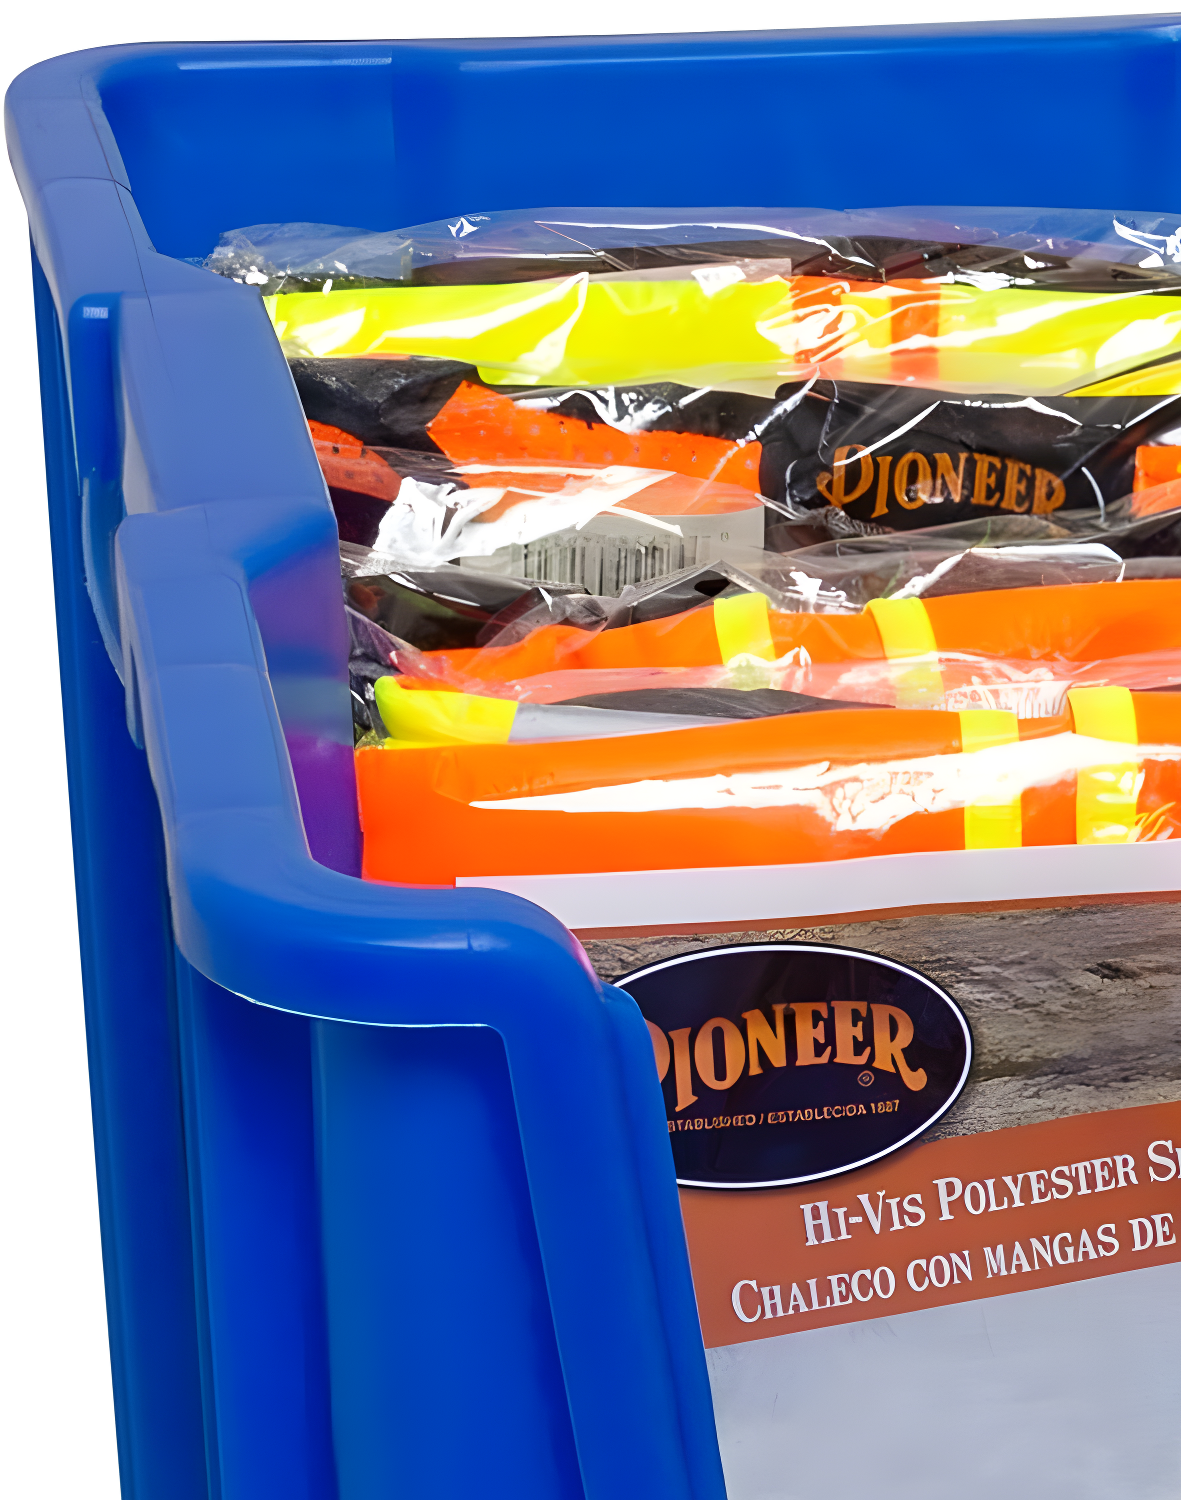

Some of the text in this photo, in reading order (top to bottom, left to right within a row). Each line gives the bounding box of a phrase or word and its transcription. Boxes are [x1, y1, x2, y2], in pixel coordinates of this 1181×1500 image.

[906, 1250, 973, 1292] CON
[983, 1223, 1119, 1279] MANGAS
[1129, 1213, 1176, 1252] DE
